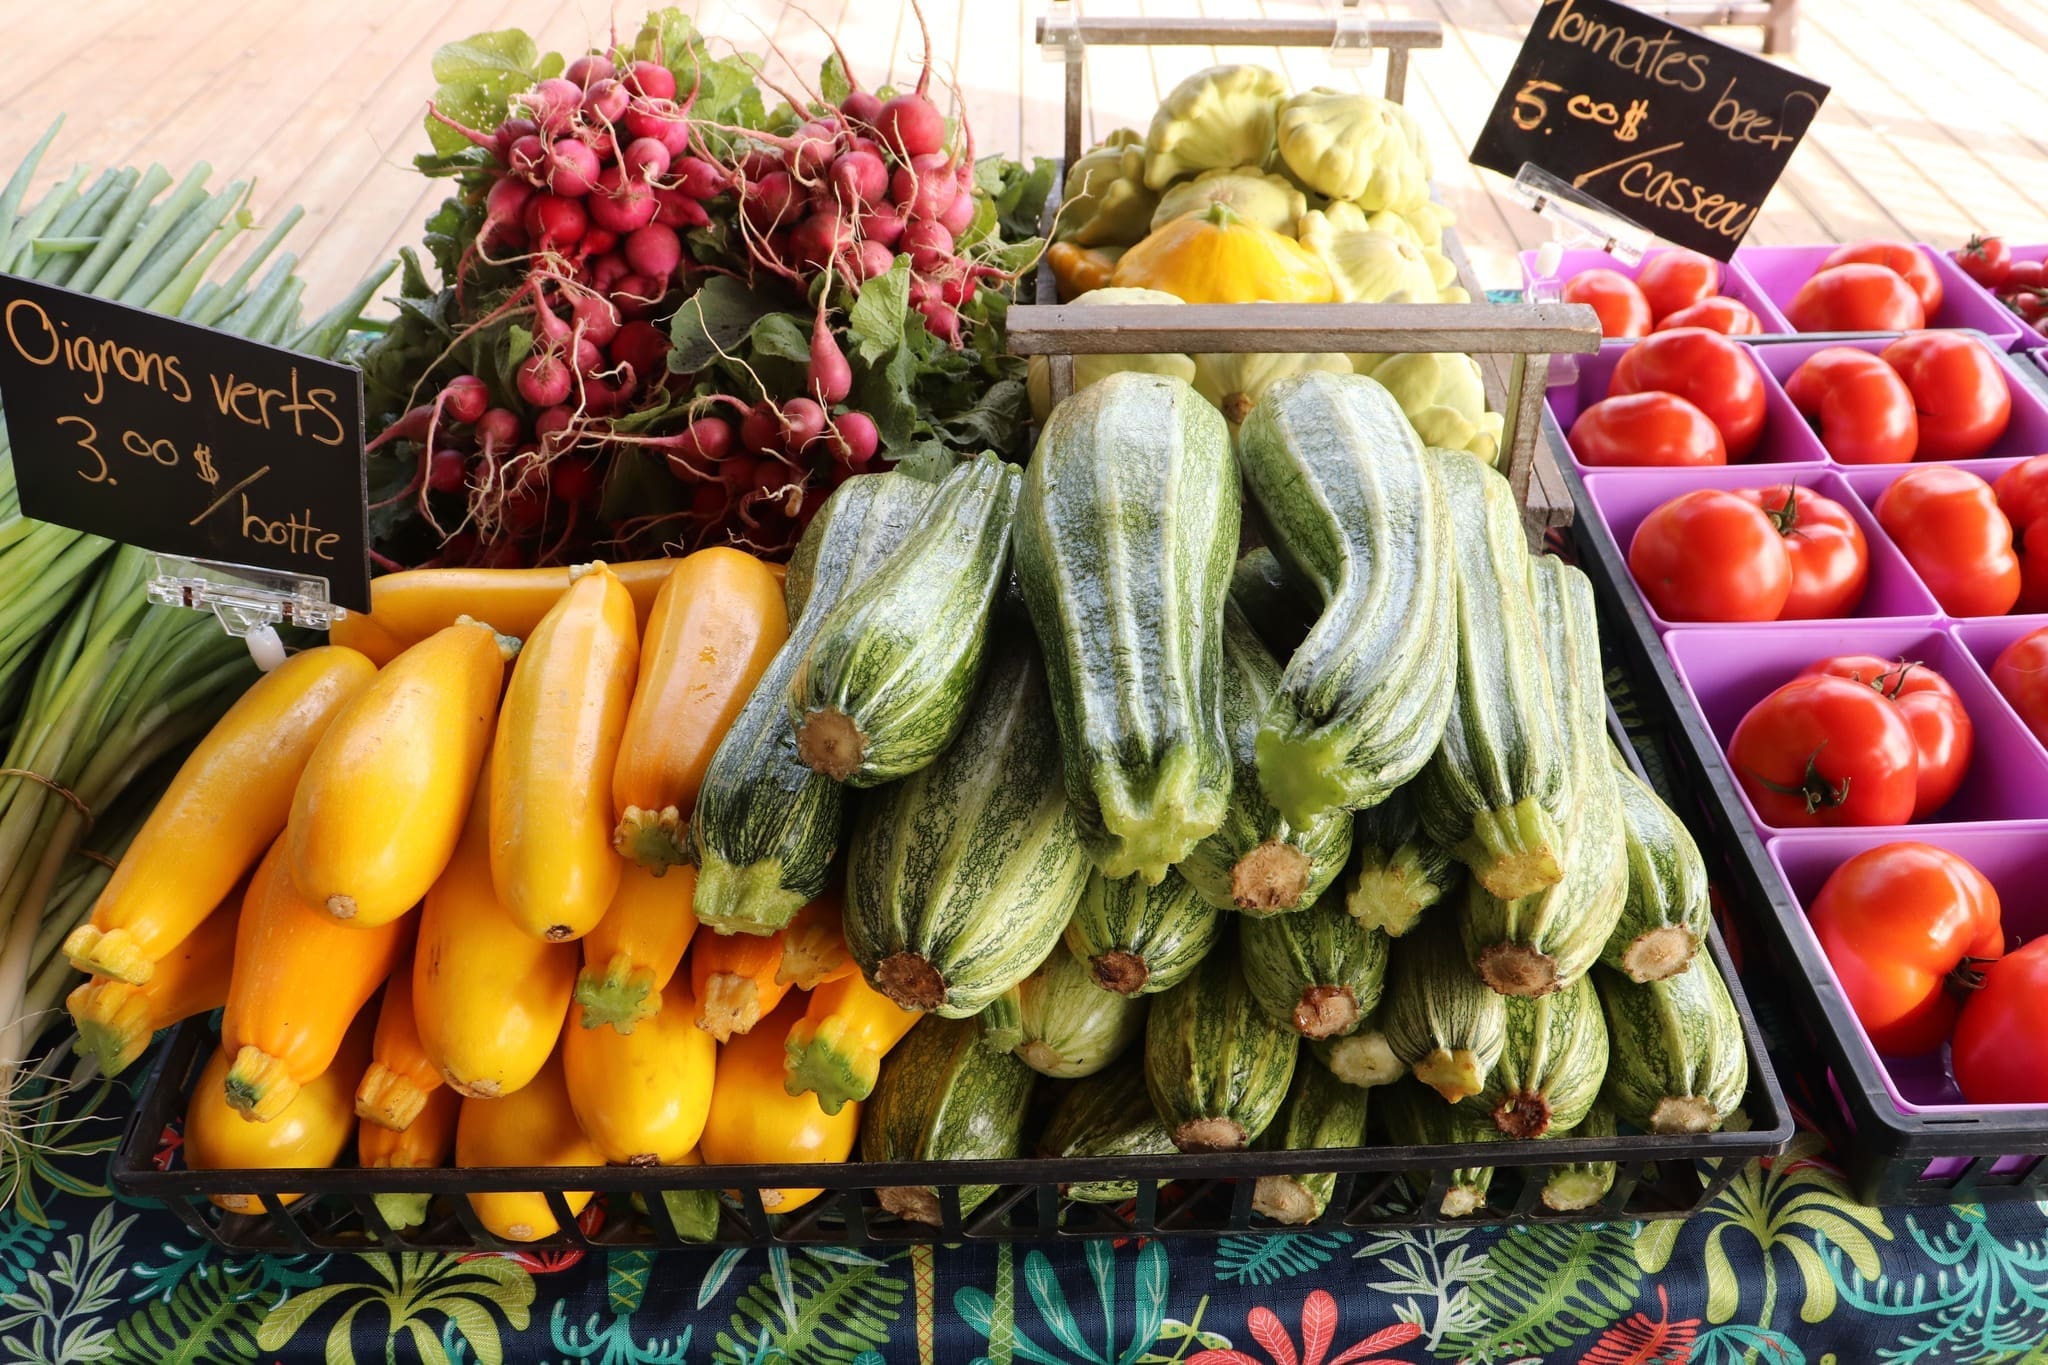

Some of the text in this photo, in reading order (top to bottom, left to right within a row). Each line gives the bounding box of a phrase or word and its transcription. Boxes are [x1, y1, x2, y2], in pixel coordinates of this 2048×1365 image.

[1545, 0, 1820, 151] Tomates beef
[5, 298, 345, 446] Oignons verts
